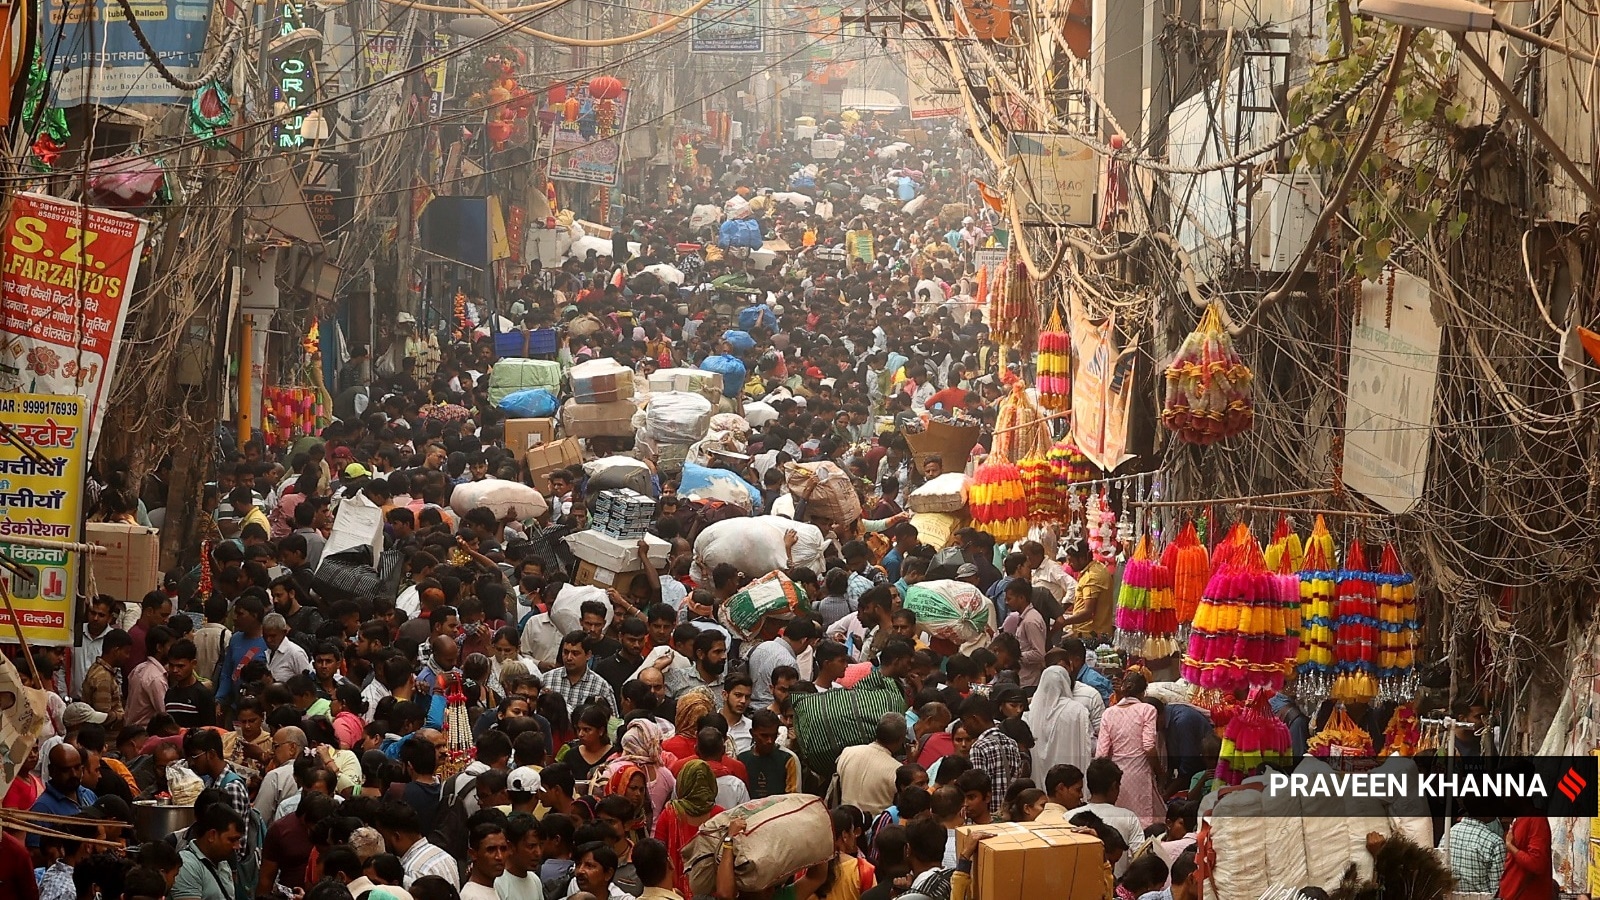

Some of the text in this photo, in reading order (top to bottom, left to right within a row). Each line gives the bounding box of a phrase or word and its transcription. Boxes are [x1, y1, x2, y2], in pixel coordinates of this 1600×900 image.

[135, 9, 165, 17] Balloon
[81, 51, 152, 62] DECOTRAD
[159, 51, 184, 61] PVT
[187, 52, 201, 62] LT
[23, 400, 78, 416] 9999176939
[18, 417, 77, 447] स्टोर
[0, 517, 71, 538] डेकोरेशन
[23, 613, 63, 624] दिल्ली-6
